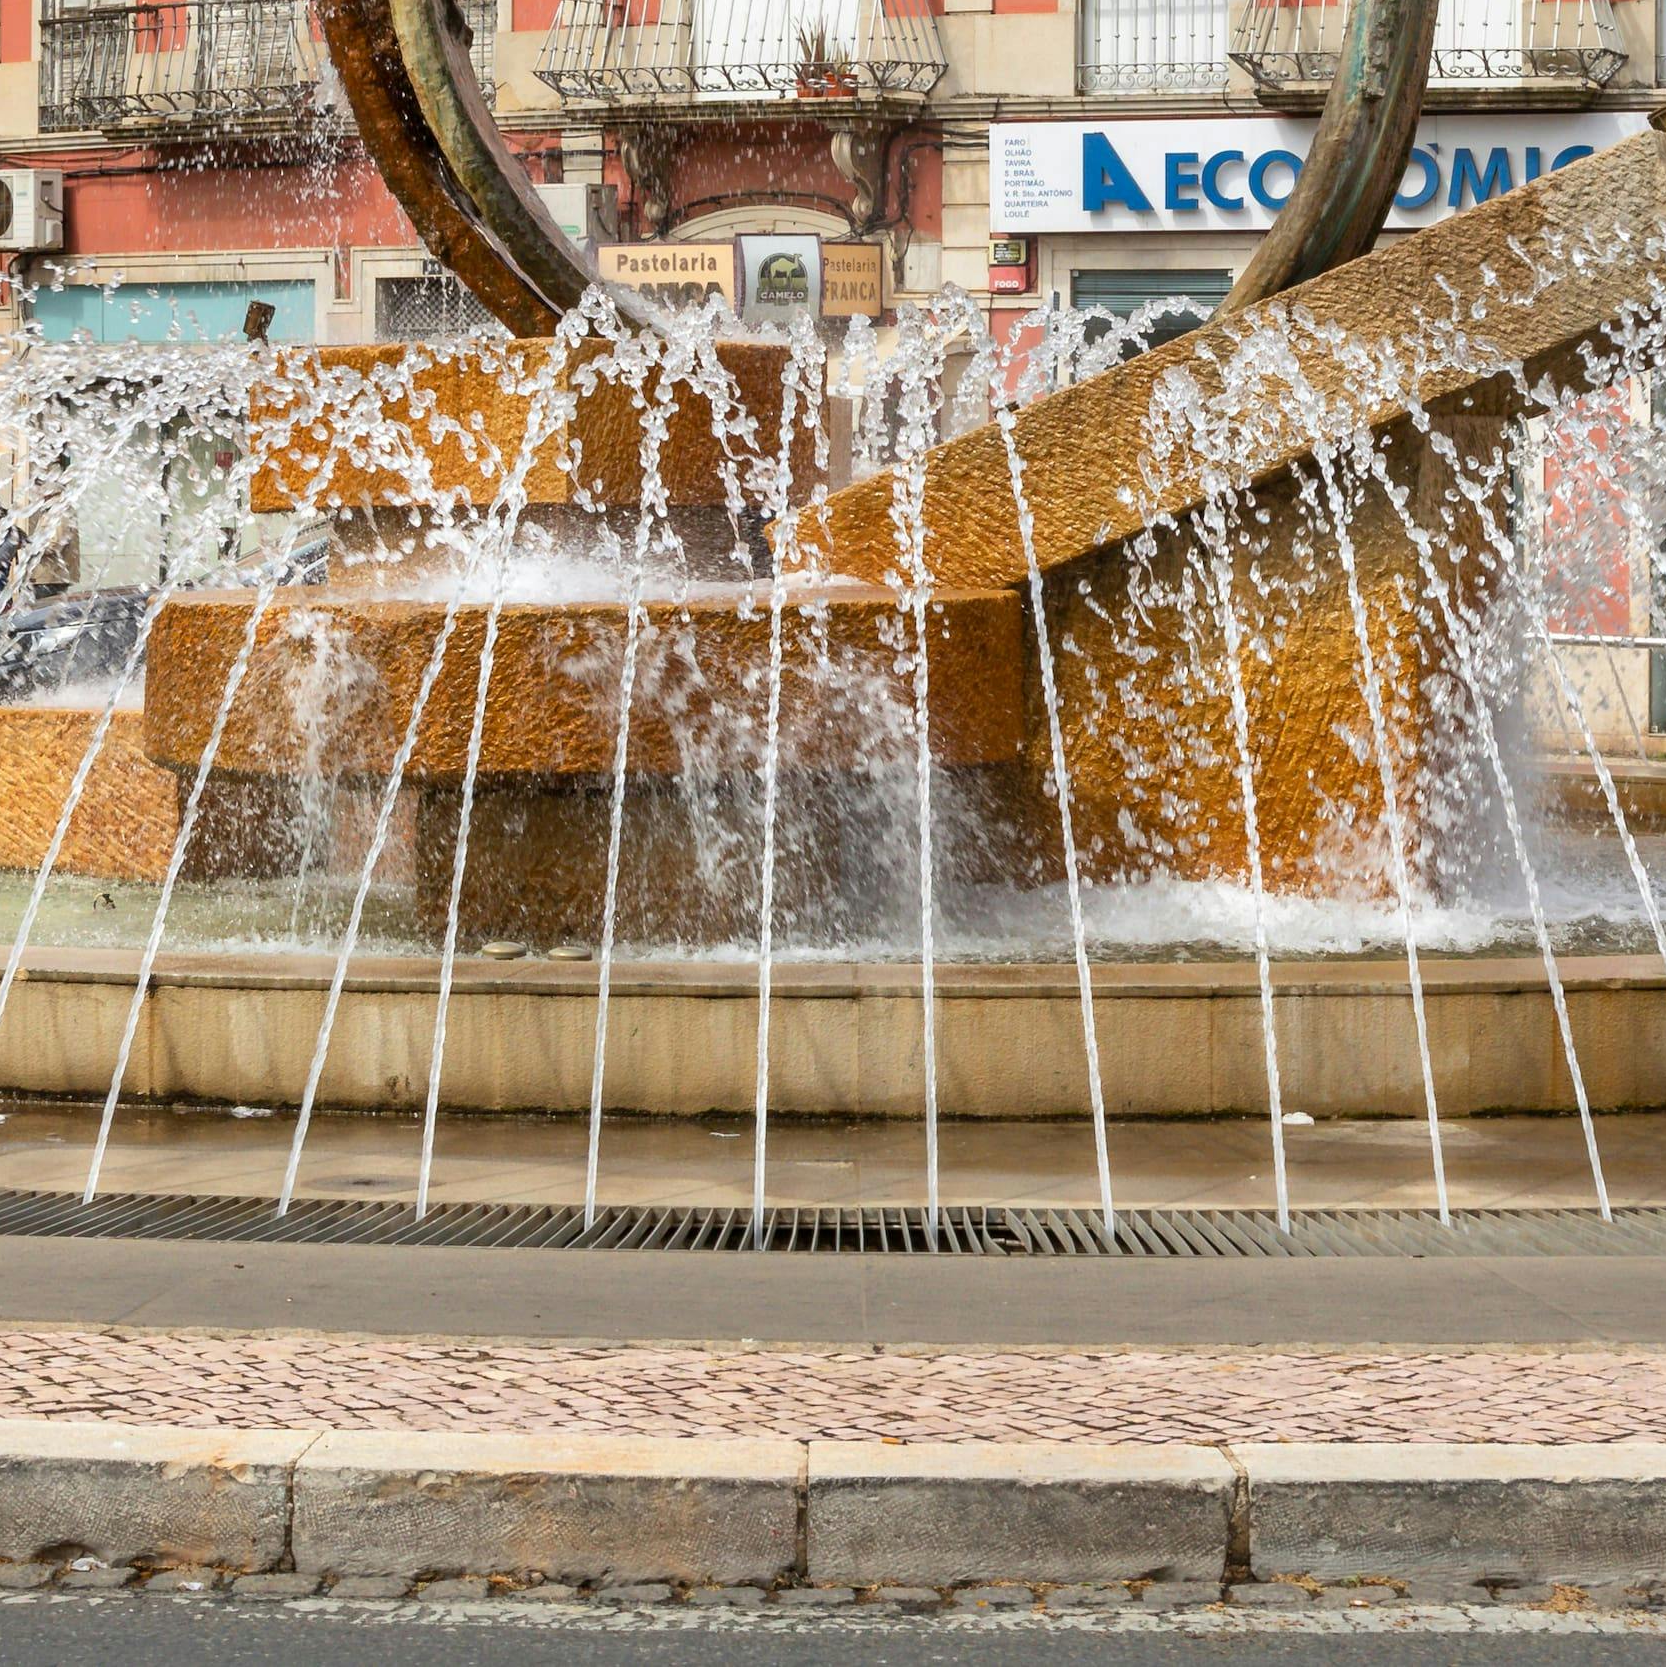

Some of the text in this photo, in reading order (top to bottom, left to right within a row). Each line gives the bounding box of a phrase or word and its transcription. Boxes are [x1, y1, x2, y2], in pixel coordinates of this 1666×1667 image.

[1004, 148, 1032, 157] OLHÃO
[1082, 132, 1155, 211] A
[1004, 179, 1045, 187] PORTIMÃO
[617, 252, 717, 273] Pastelaria
[823, 257, 877, 274] Pastelaria
[994, 280, 1019, 288] FOGO
[759, 291, 805, 300] CAMELO
